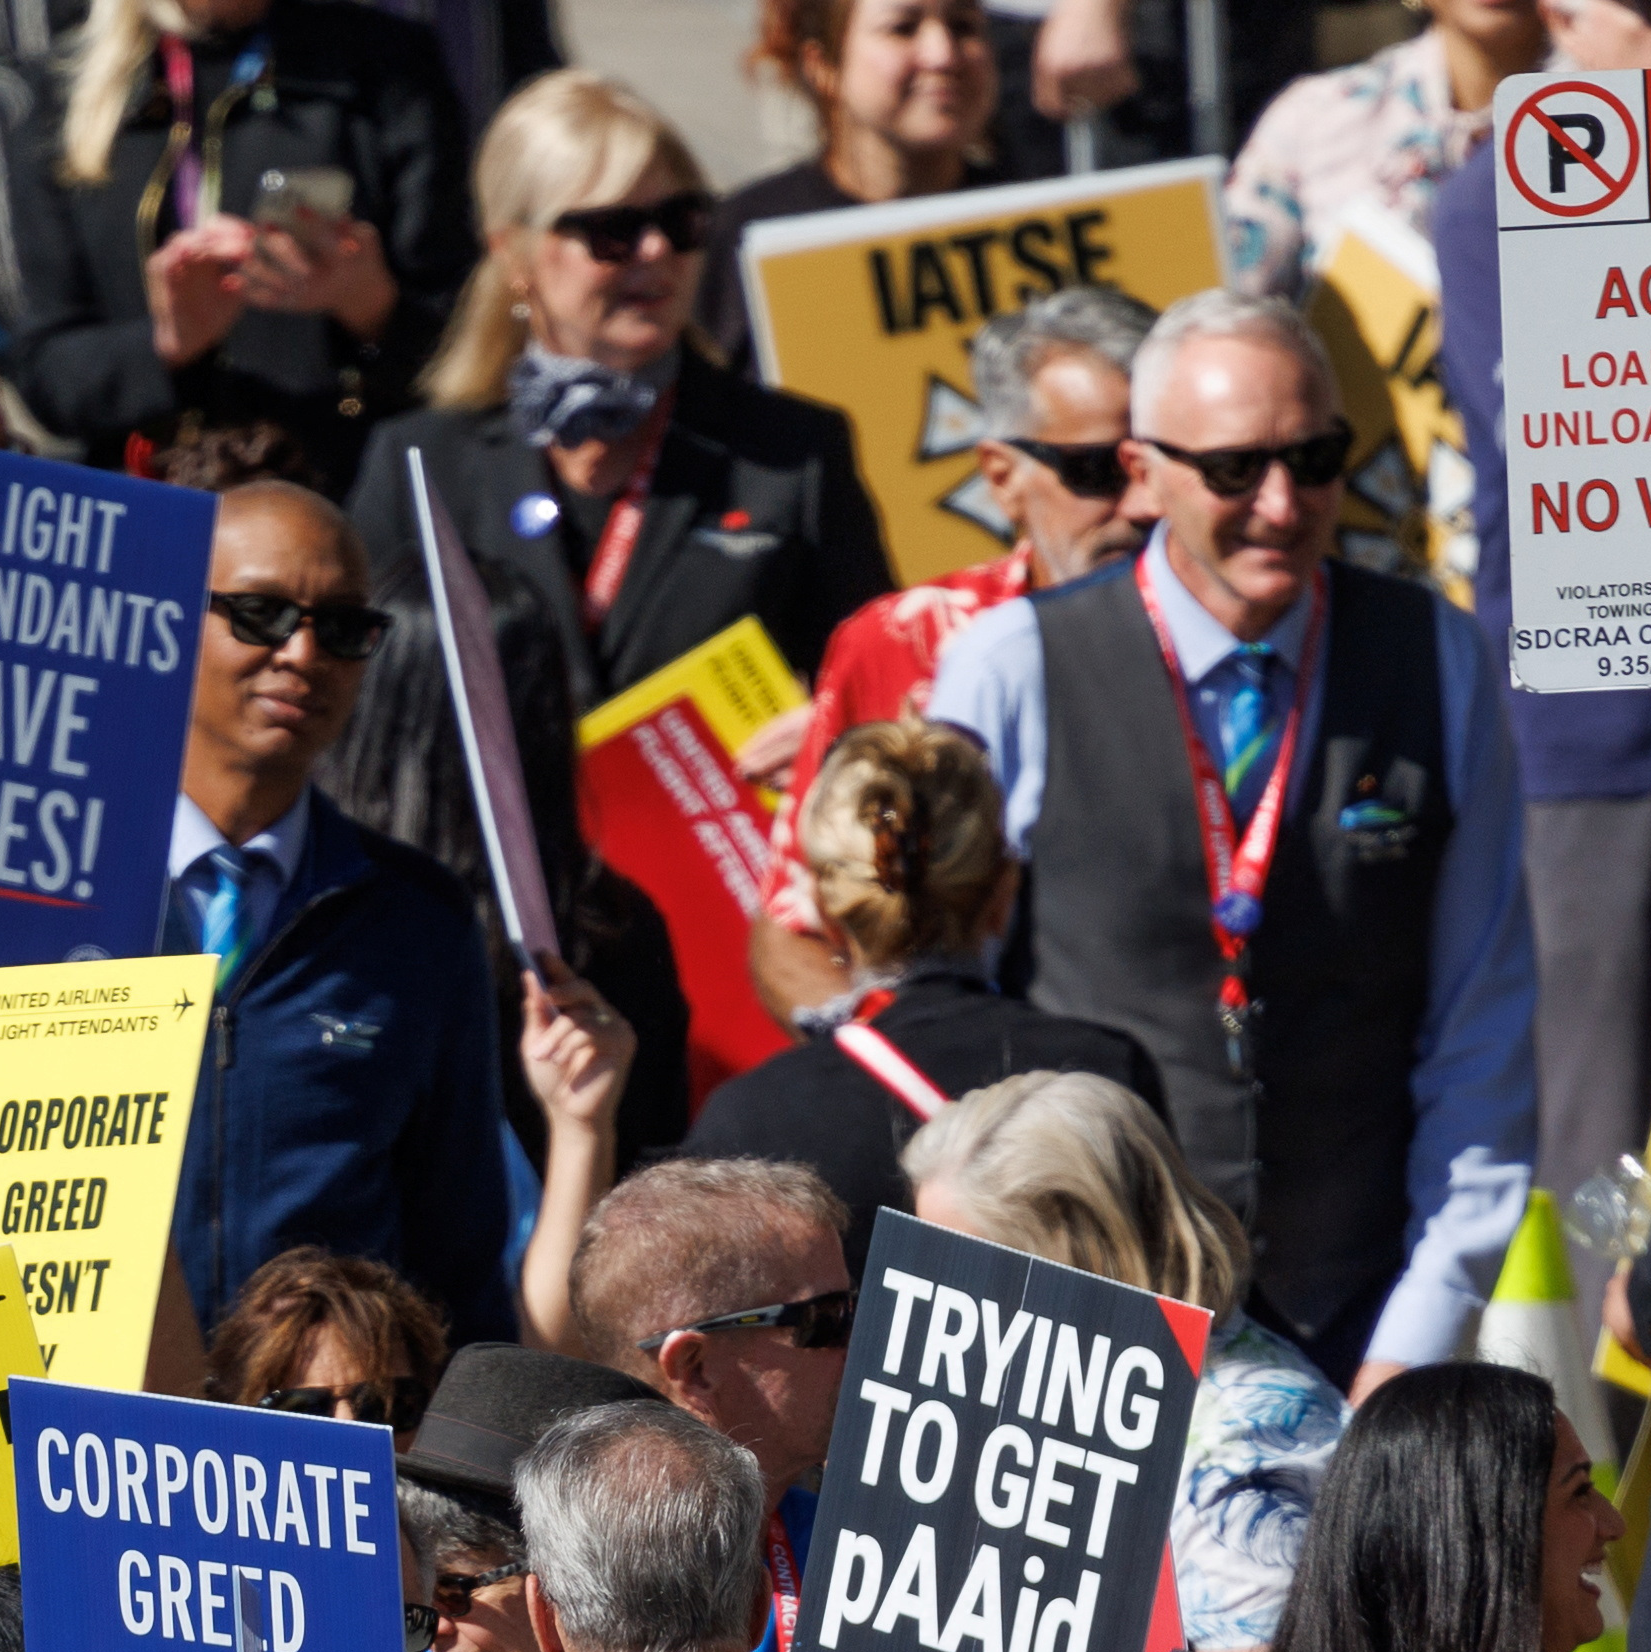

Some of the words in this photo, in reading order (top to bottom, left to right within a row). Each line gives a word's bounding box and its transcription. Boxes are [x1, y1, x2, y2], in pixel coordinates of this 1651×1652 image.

[868, 210, 1116, 336] IATSE
[1532, 479, 1619, 534] NO
[1516, 626, 1631, 650] SDCRAA
[45, 1016, 158, 1036] ATTENDANTS
[56, 987, 130, 1005] AIRLINES
[2, 1178, 107, 1235] GREED
[883, 1268, 1164, 1450] TRYING
[38, 1428, 376, 1555] CORPORATE
[860, 1379, 958, 1503] TO
[975, 1425, 1139, 1558] GET
[773, 1543, 796, 1636] CONTRACT
